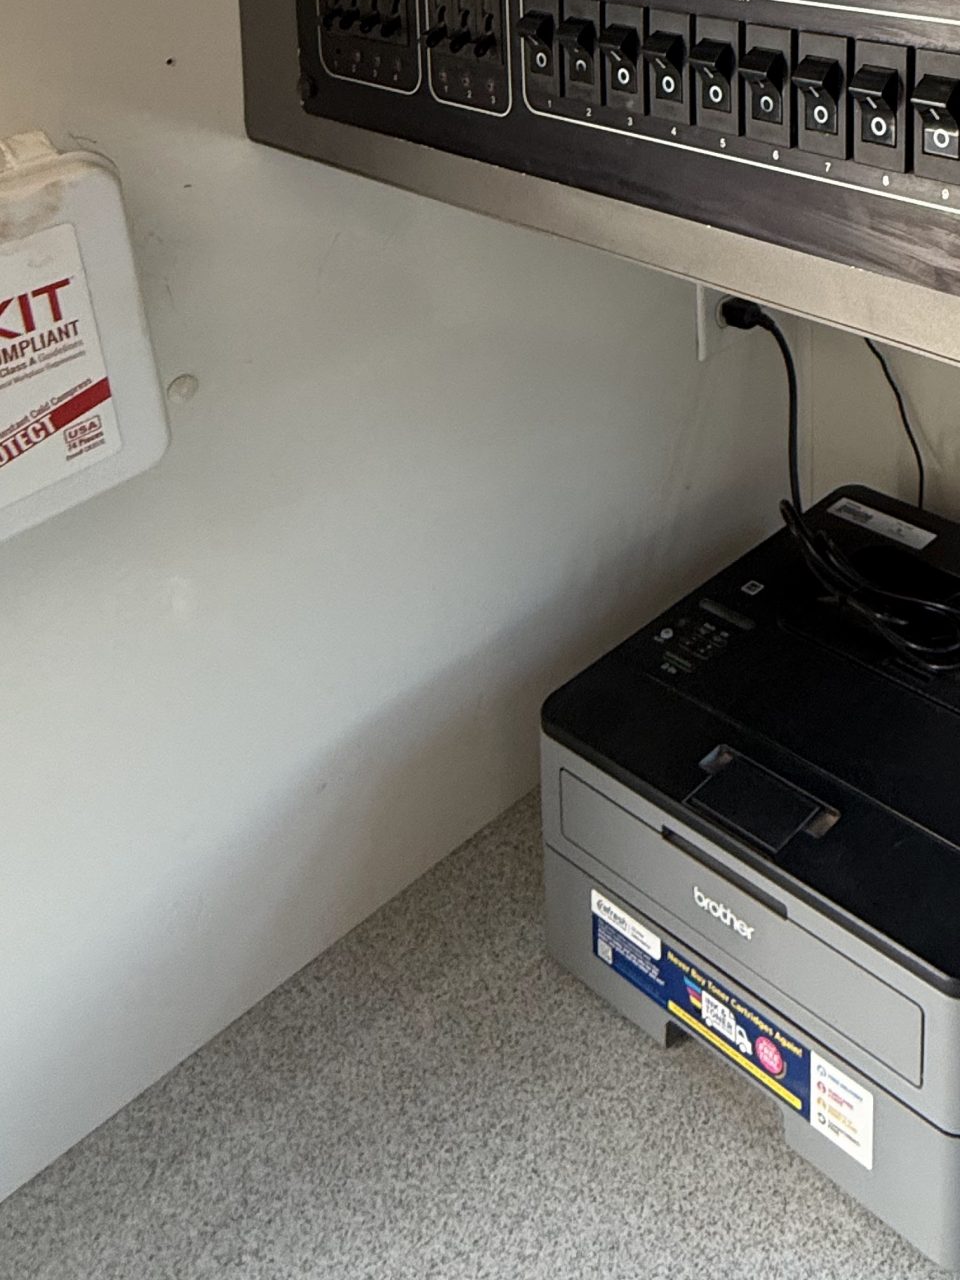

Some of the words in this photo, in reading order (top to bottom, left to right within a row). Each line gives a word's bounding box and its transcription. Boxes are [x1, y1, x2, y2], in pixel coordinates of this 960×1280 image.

[586, 108, 592, 117] 2
[627, 116, 633, 126] 3
[671, 126, 677, 136] 4
[720, 138, 726, 148] 5
[773, 150, 779, 160] 6
[825, 162, 831, 172] 7
[942, 188, 949, 200] 9
[68, 421, 98, 439] USA
[694, 886, 755, 940] brother
[690, 968, 706, 986] Buy
[707, 979, 729, 1003] Toner
[730, 998, 773, 1036] Cartridges
